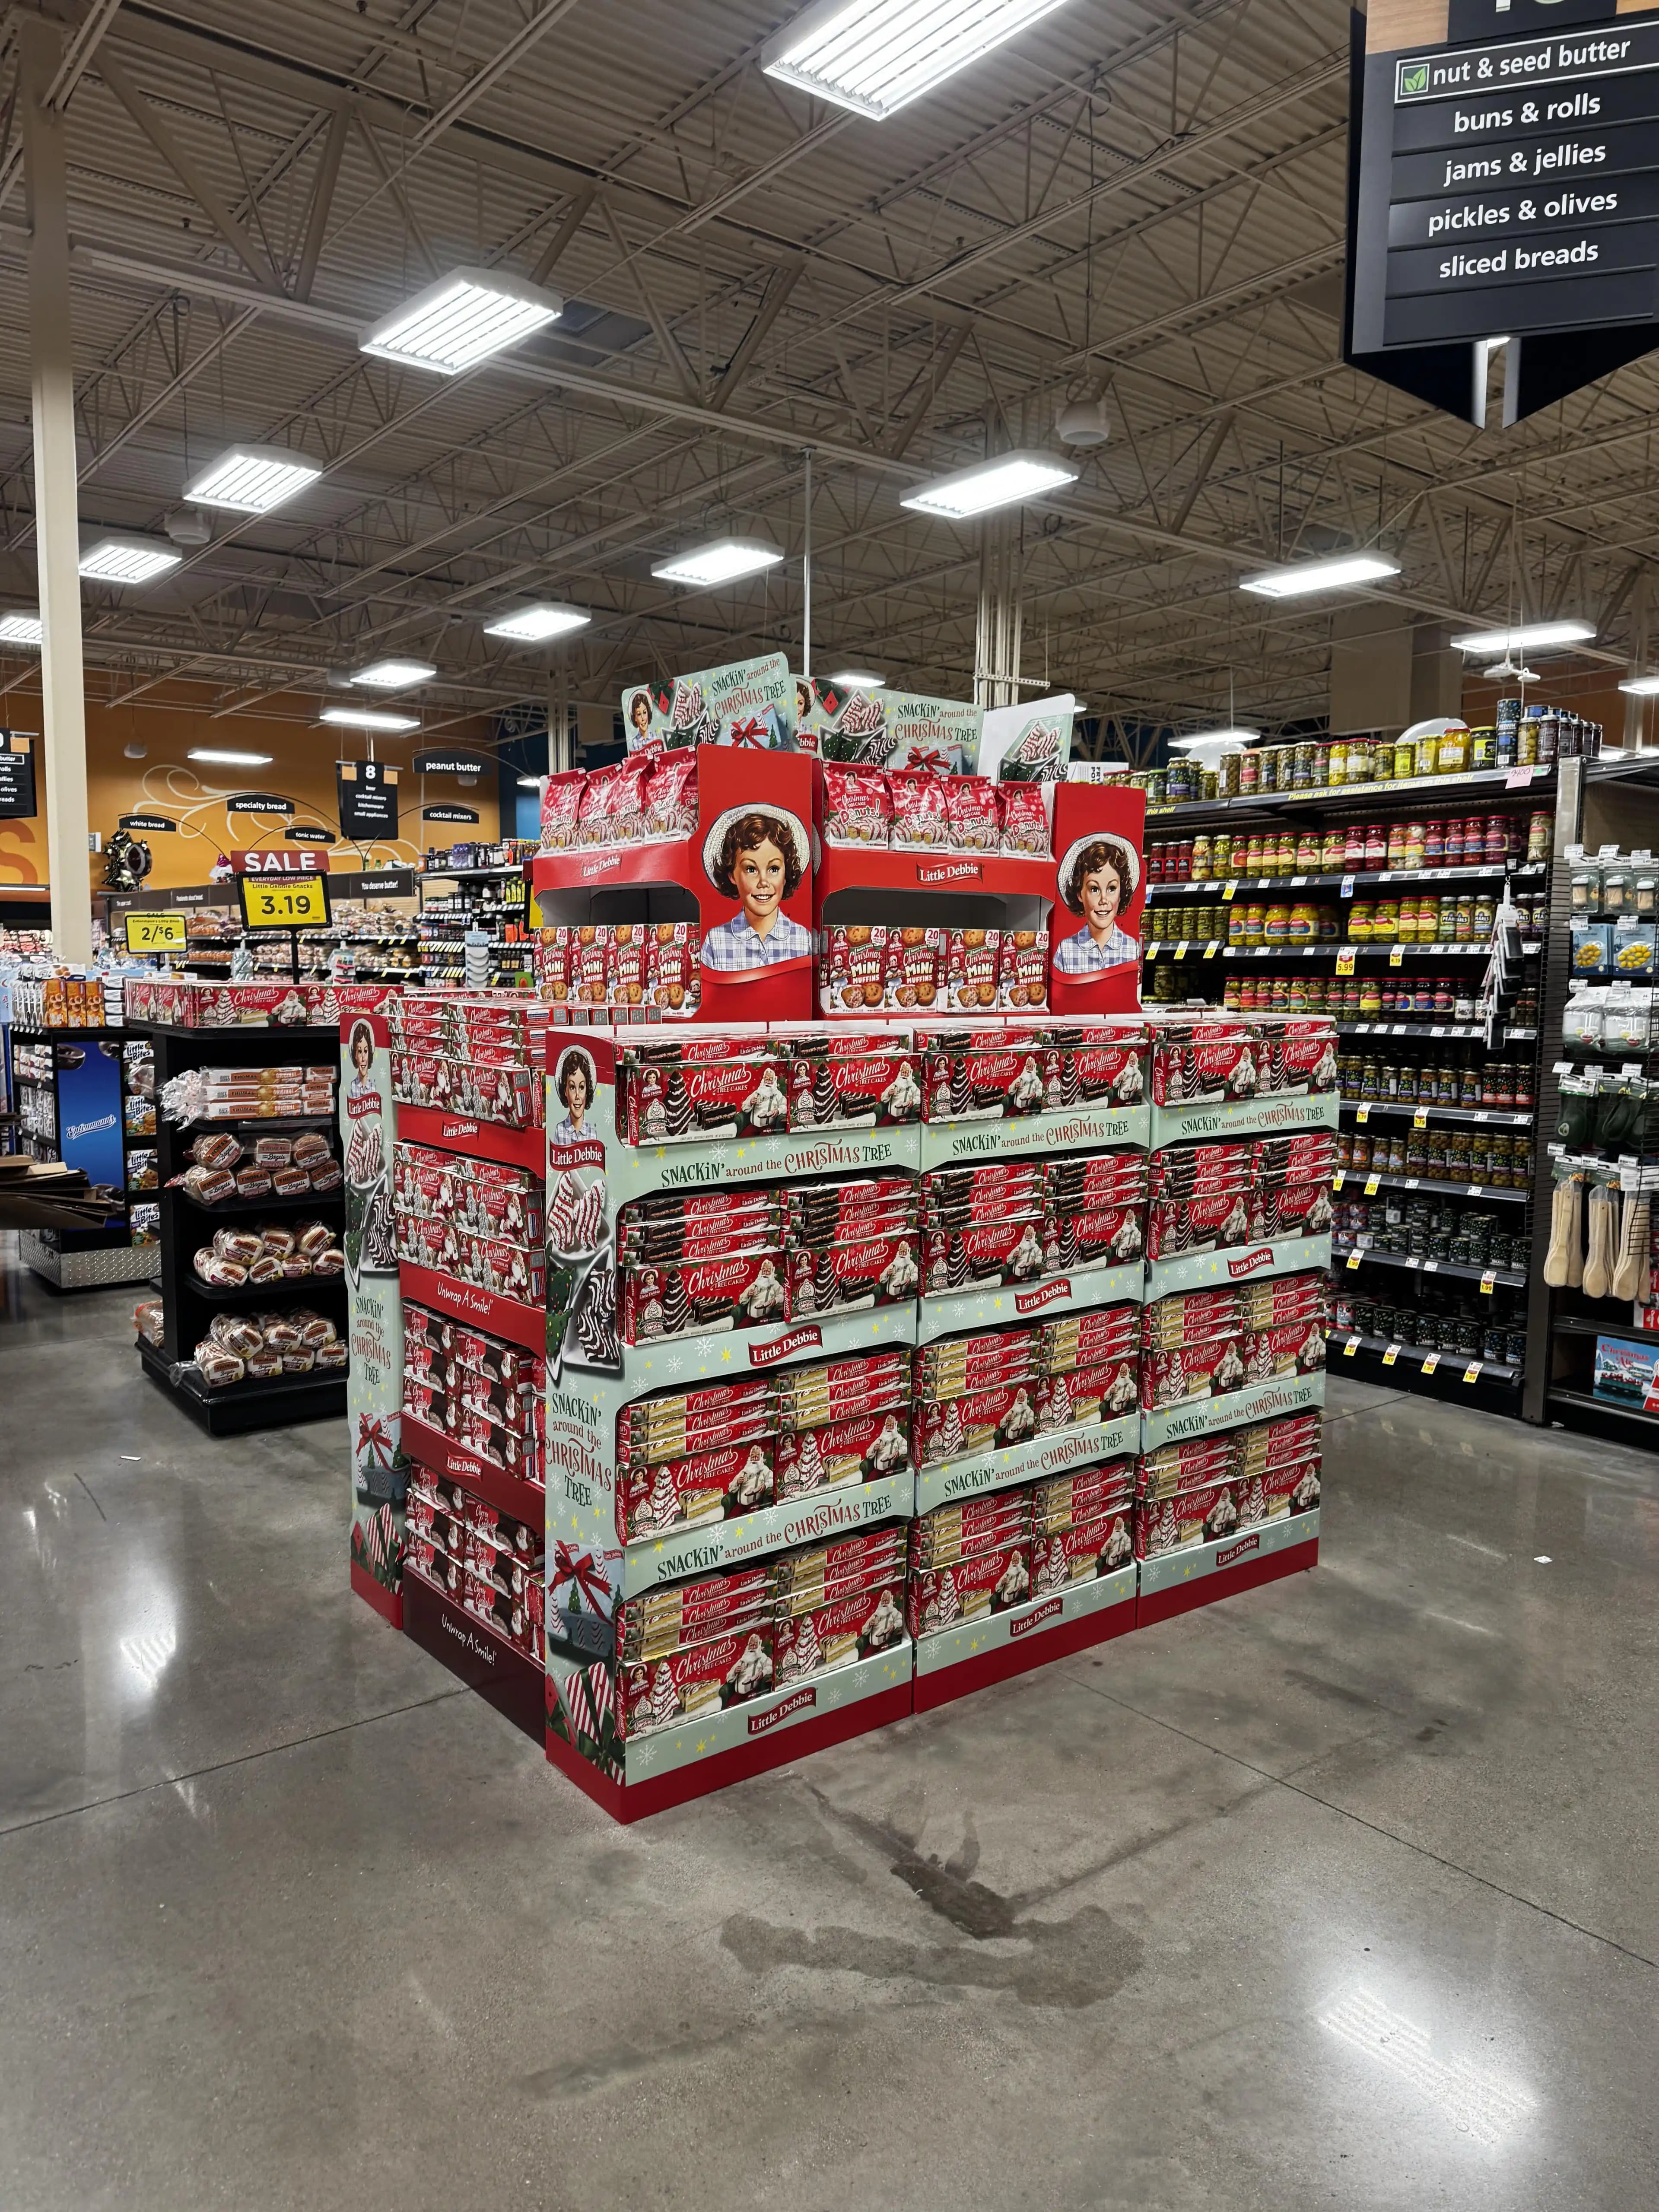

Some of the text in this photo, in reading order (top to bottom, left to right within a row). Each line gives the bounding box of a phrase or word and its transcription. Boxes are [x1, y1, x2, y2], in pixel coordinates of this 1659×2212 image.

[1433, 41, 1630, 85] nut & seed butter
[1454, 93, 1601, 133] buns & rolls
[1444, 143, 1606, 187] jams & jellies
[1429, 193, 1617, 236] pickles & olives
[1440, 241, 1598, 278] sliced breads
[747, 664, 768, 680] around
[768, 658, 780, 671] the
[714, 680, 786, 719] CHRISTMAS TREE
[940, 709, 964, 718] around
[965, 708, 977, 717] the
[895, 718, 977, 742] CHRISTMAS TREE
[365, 765, 376, 779] 8
[426, 762, 481, 772] peanut butter
[1288, 792, 1313, 801] Please
[1341, 784, 1382, 795] assistance
[1384, 782, 1396, 790] for
[235, 802, 286, 810] specialty bread
[840, 799, 880, 824] Donuts!
[245, 852, 318, 872] SALE
[583, 855, 620, 877] Little Debbie
[920, 863, 979, 881] Little Debbie
[369, 881, 384, 890] deserve
[385, 880, 398, 889] butter!
[261, 896, 311, 915] 3.19
[142, 925, 174, 943] 2/$6
[874, 928, 885, 938] 20
[852, 974, 880, 984] MUFFINS
[234, 986, 279, 1004] Christmas
[127, 1044, 144, 1055] Little
[132, 1050, 150, 1061] Bites
[690, 1062, 752, 1098] Christmas
[713, 1087, 729, 1096] TREE
[348, 1098, 380, 1116] Little Debbie
[1221, 1118, 1245, 1129] around
[1247, 1115, 1257, 1125] the
[1258, 1101, 1305, 1128] CHRISTMAS
[1306, 1106, 1325, 1121] TREE
[443, 1124, 478, 1137] Little Debbie
[1001, 1135, 1030, 1148] around
[1032, 1132, 1044, 1142] the
[1046, 1116, 1105, 1146] CHRISTMAS
[1106, 1120, 1129, 1137] TREE
[552, 1145, 602, 1163] Little Debbie
[726, 1163, 763, 1177] around
[766, 1160, 782, 1171] the
[784, 1138, 860, 1175] CHRISTMAS
[862, 1143, 892, 1162] TREE
[1230, 1252, 1271, 1276] Little Debbie
[437, 1281, 493, 1315] Unwrap A Smile!
[1018, 1283, 1068, 1310] Little Debbie
[357, 1318, 384, 1336] around the
[351, 1332, 391, 1370] CHRISTMAS
[752, 1328, 818, 1364] Little Debbie
[364, 1365, 380, 1385] TREE
[1208, 1412, 1233, 1427] around
[1234, 1408, 1244, 1418] the
[1245, 1387, 1293, 1420] CHRISTMAS
[1294, 1387, 1312, 1404] TREE
[553, 1420, 602, 1450] around the
[447, 1457, 482, 1476] Little Debbie
[545, 1437, 612, 1492] CHRISTMAS
[995, 1464, 1025, 1481] around
[1027, 1457, 1039, 1469] the
[1040, 1432, 1100, 1470] CHRISTMAS
[1100, 1431, 1124, 1450] TREE
[564, 1475, 592, 1506] TREE
[725, 1538, 763, 1559] around
[766, 1530, 782, 1546] the
[784, 1498, 860, 1545] CHRISTMAS
[862, 1494, 892, 1518] TREE
[1217, 1537, 1258, 1564] Little Debbie
[1012, 1602, 1061, 1634] Little Debbie
[442, 1614, 496, 1666] Unwrap A Smile!
[751, 1692, 813, 1731] Little Debbie
